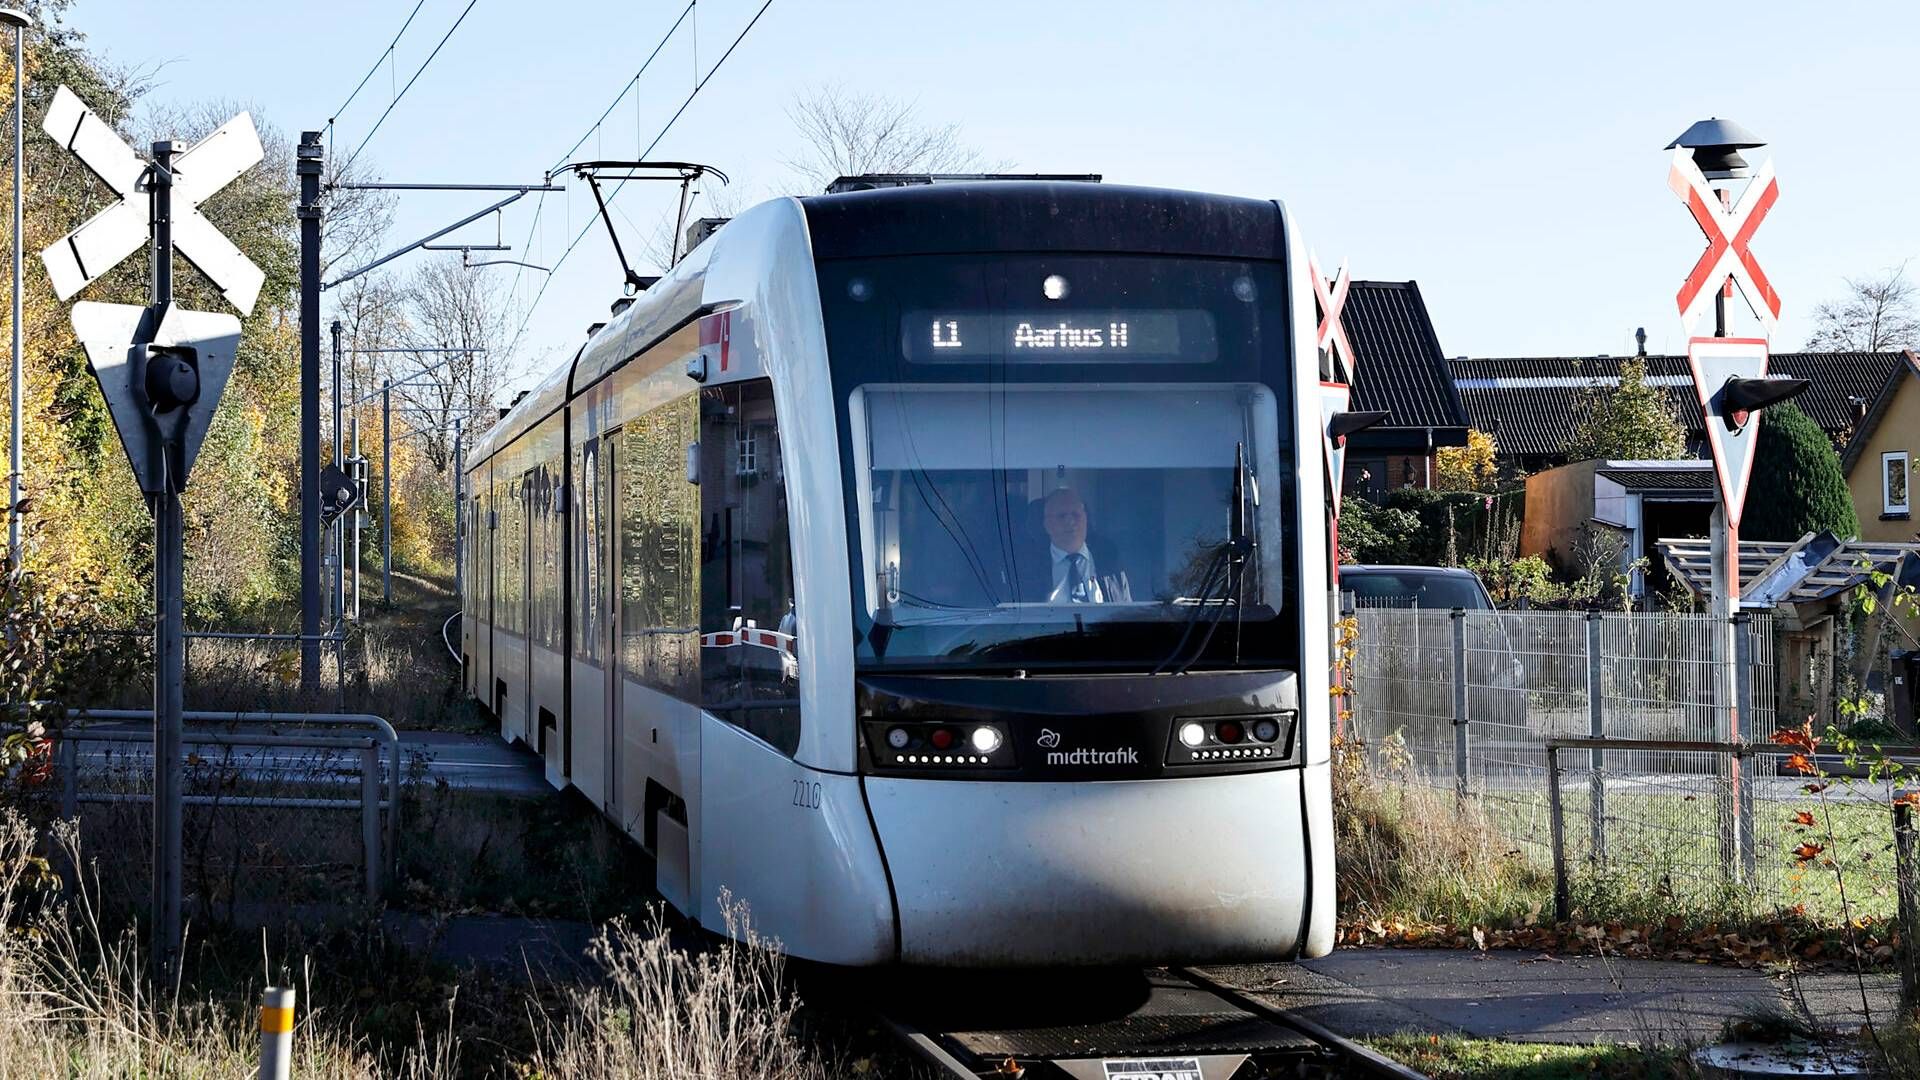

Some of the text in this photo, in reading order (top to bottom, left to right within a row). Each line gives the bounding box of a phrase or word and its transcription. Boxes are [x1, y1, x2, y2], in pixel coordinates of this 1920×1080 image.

[932, 321, 1128, 348] L1 Aarhus H
[1047, 747, 1139, 766] midttrafik
[792, 779, 822, 810] 2210
